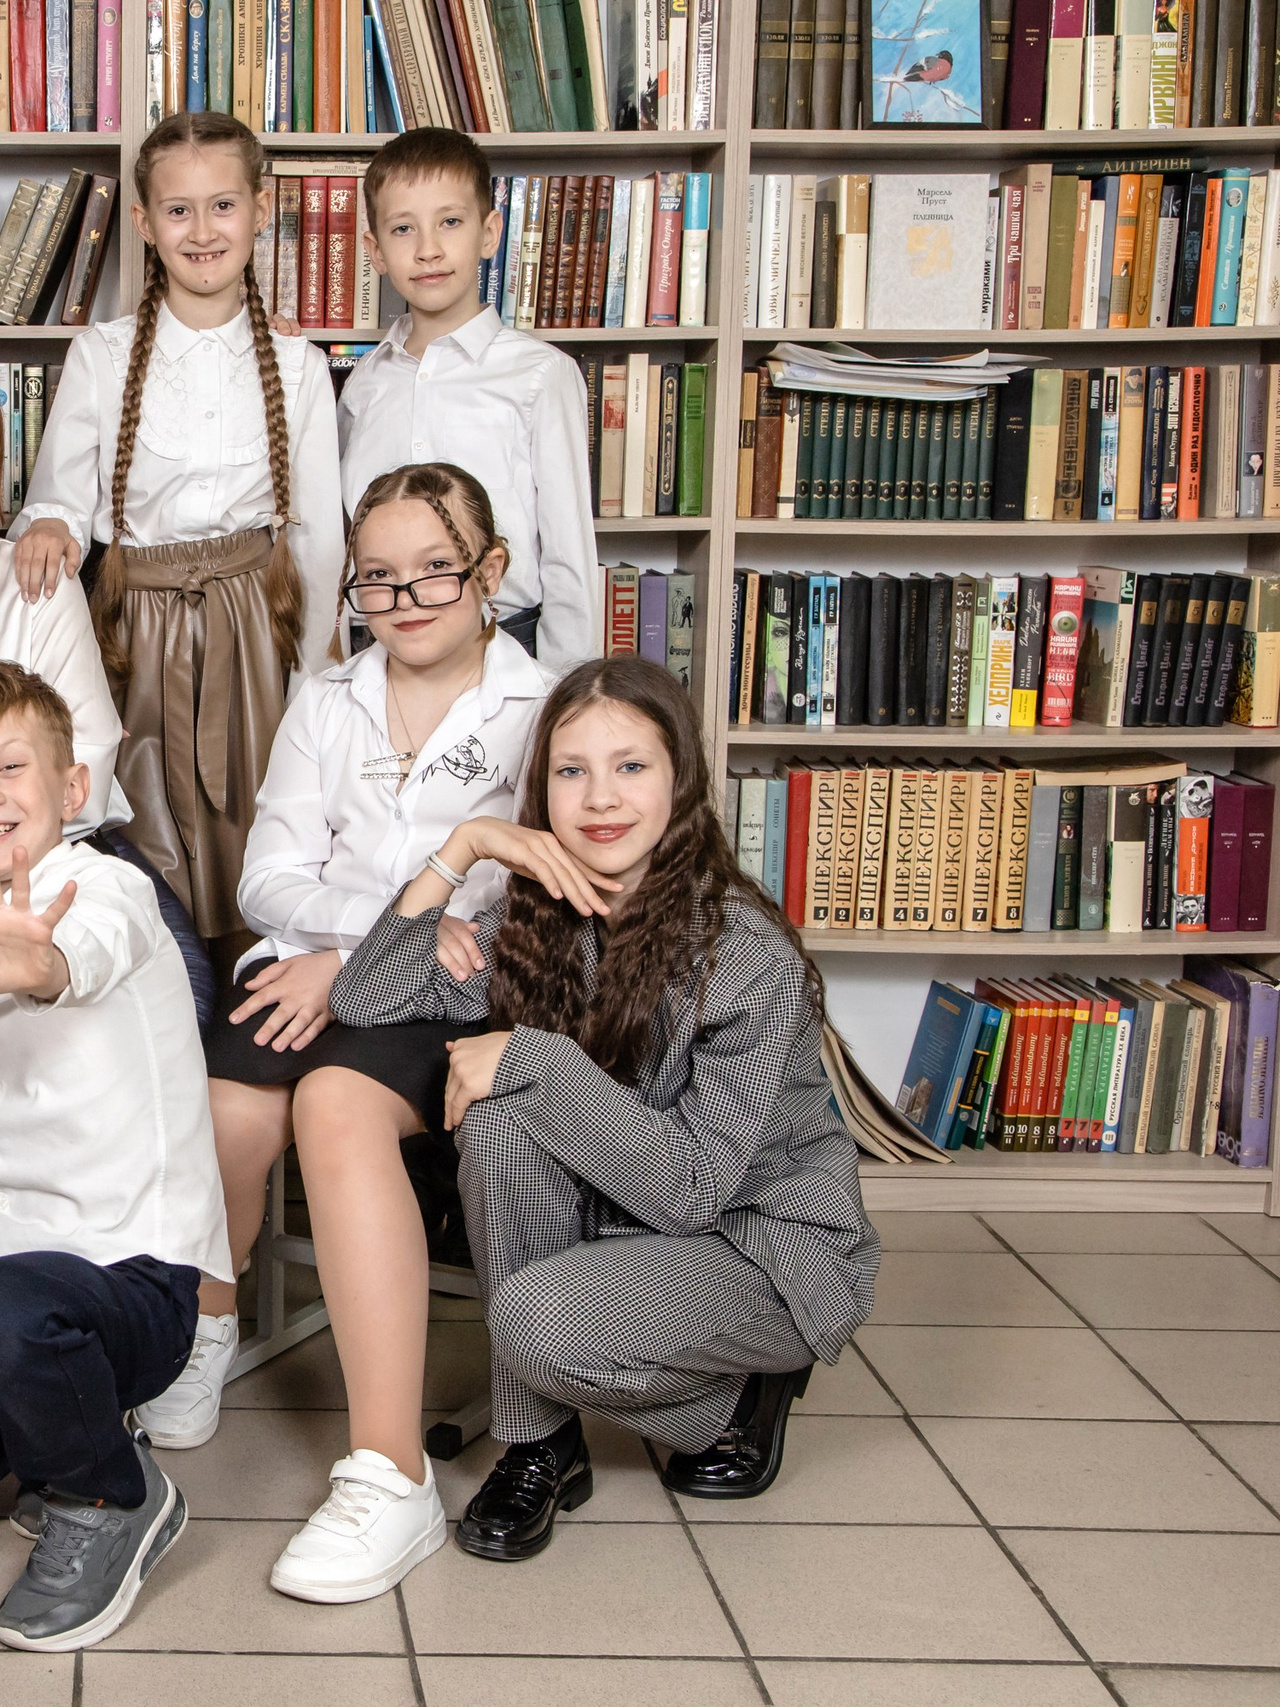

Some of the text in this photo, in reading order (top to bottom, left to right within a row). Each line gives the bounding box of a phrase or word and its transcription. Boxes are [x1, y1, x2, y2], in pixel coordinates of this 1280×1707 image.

[104, 40, 114, 65] СТЮАРТ
[191, 30, 201, 83] Дом на берегу
[399, 28, 417, 75] СЕРЕБРЯНЫЙ
[698, 20, 713, 50] СПОК
[1152, 40, 1178, 49] ДЖОН
[1181, 13, 1190, 61] АЛЬГАМБРА
[1149, 49, 1177, 123] ИРВИНГ
[1223, 47, 1235, 118] Ярослав Ивашкевич
[1102, 157, 1191, 173] А.И.ГЕРЦЕН
[913, 214, 954, 222] ПЛЕННИЦА
[917, 188, 952, 198] Марсель
[922, 198, 947, 206] Пруст
[26, 196, 69, 299] Чарльз Лэм ОЧЕРКИ ЭЛИИ
[1007, 190, 1021, 263] Три чашки чая
[1166, 220, 1174, 240] РАДИ
[508, 240, 519, 271] МЕРДОК
[659, 218, 673, 293] Призрак Оперы
[768, 232, 781, 324] ДЭВИД МИТЧЕЛЛ
[361, 281, 370, 320] ГЕНРИХ
[981, 260, 992, 313] мураками
[1055, 377, 1081, 499] СТЕНДАЛЬ
[1151, 412, 1160, 466] ПРОИСХОЖДЕНИЕ
[1167, 413, 1179, 429] ЭТОТ
[1191, 374, 1201, 473] ОДИН РАЗ НЕДОСТАТОЧНО
[1193, 606, 1200, 616] 5
[1212, 608, 1218, 617] 6
[1234, 607, 1240, 616] 7
[741, 643, 752, 712] ДОЧЬ МОНТЕСУМЫ
[988, 645, 1012, 706] ХЕЛПРИН
[1131, 639, 1148, 705] СТЕФАН ЦВЕЙГ
[1174, 641, 1194, 706] СТЕФАН ЦВЕЙГ
[1195, 638, 1214, 703] СТЕФАН ЦВЕЙГ
[814, 783, 836, 903] ШЕКСПИР
[835, 783, 860, 904] ШЕКСПИР
[861, 781, 887, 904] ШЕКСПИР
[894, 782, 916, 904] ШЕКСПИР
[914, 782, 938, 904] ШЕКСПИР
[942, 784, 966, 903] ШЕКСПИР
[973, 783, 997, 903] ШЕКСПИР
[1006, 781, 1029, 902] ШЕКСПИР
[818, 909, 825, 918] 1
[838, 909, 846, 920] 2
[863, 909, 871, 920] 3
[896, 909, 905, 920] 4
[917, 909, 925, 920] 5
[945, 909, 952, 920] 6
[977, 909, 983, 920] 7
[1010, 907, 1017, 919] 8
[1011, 1033, 1025, 1086] Литература
[1026, 1033, 1038, 1086] Литература
[1054, 1034, 1068, 1086] Литература
[1070, 1029, 1083, 1091] ЛИТЕРАТУРА
[1151, 1022, 1160, 1048] СЛОВАРЬ
[1038, 1034, 1051, 1087] Литература
[1098, 1030, 1112, 1093] ЛИТЕРАТУРА
[1109, 1026, 1126, 1121] РУССКАЯ ЛИТЕРАТУРА ВЕКА
[1143, 1050, 1157, 1109] ТОПОНИМИЧЕСКИЙ
[1173, 1027, 1193, 1124] Орфографический словарь
[1212, 1066, 1221, 1095] РУССКИЙ
[1250, 1036, 1268, 1119] ЯЗЫКОЗНАНИЕ
[1004, 1125, 1015, 1135] 10
[1017, 1125, 1027, 1134] 10
[1033, 1126, 1040, 1135] 8
[1048, 1125, 1055, 1134] 8
[1064, 1121, 1072, 1130] 7
[1080, 1121, 1087, 1130] 7
[1093, 1122, 1100, 1131] 7
[1138, 1111, 1149, 1146] ШКОЛЬНЫЙ
